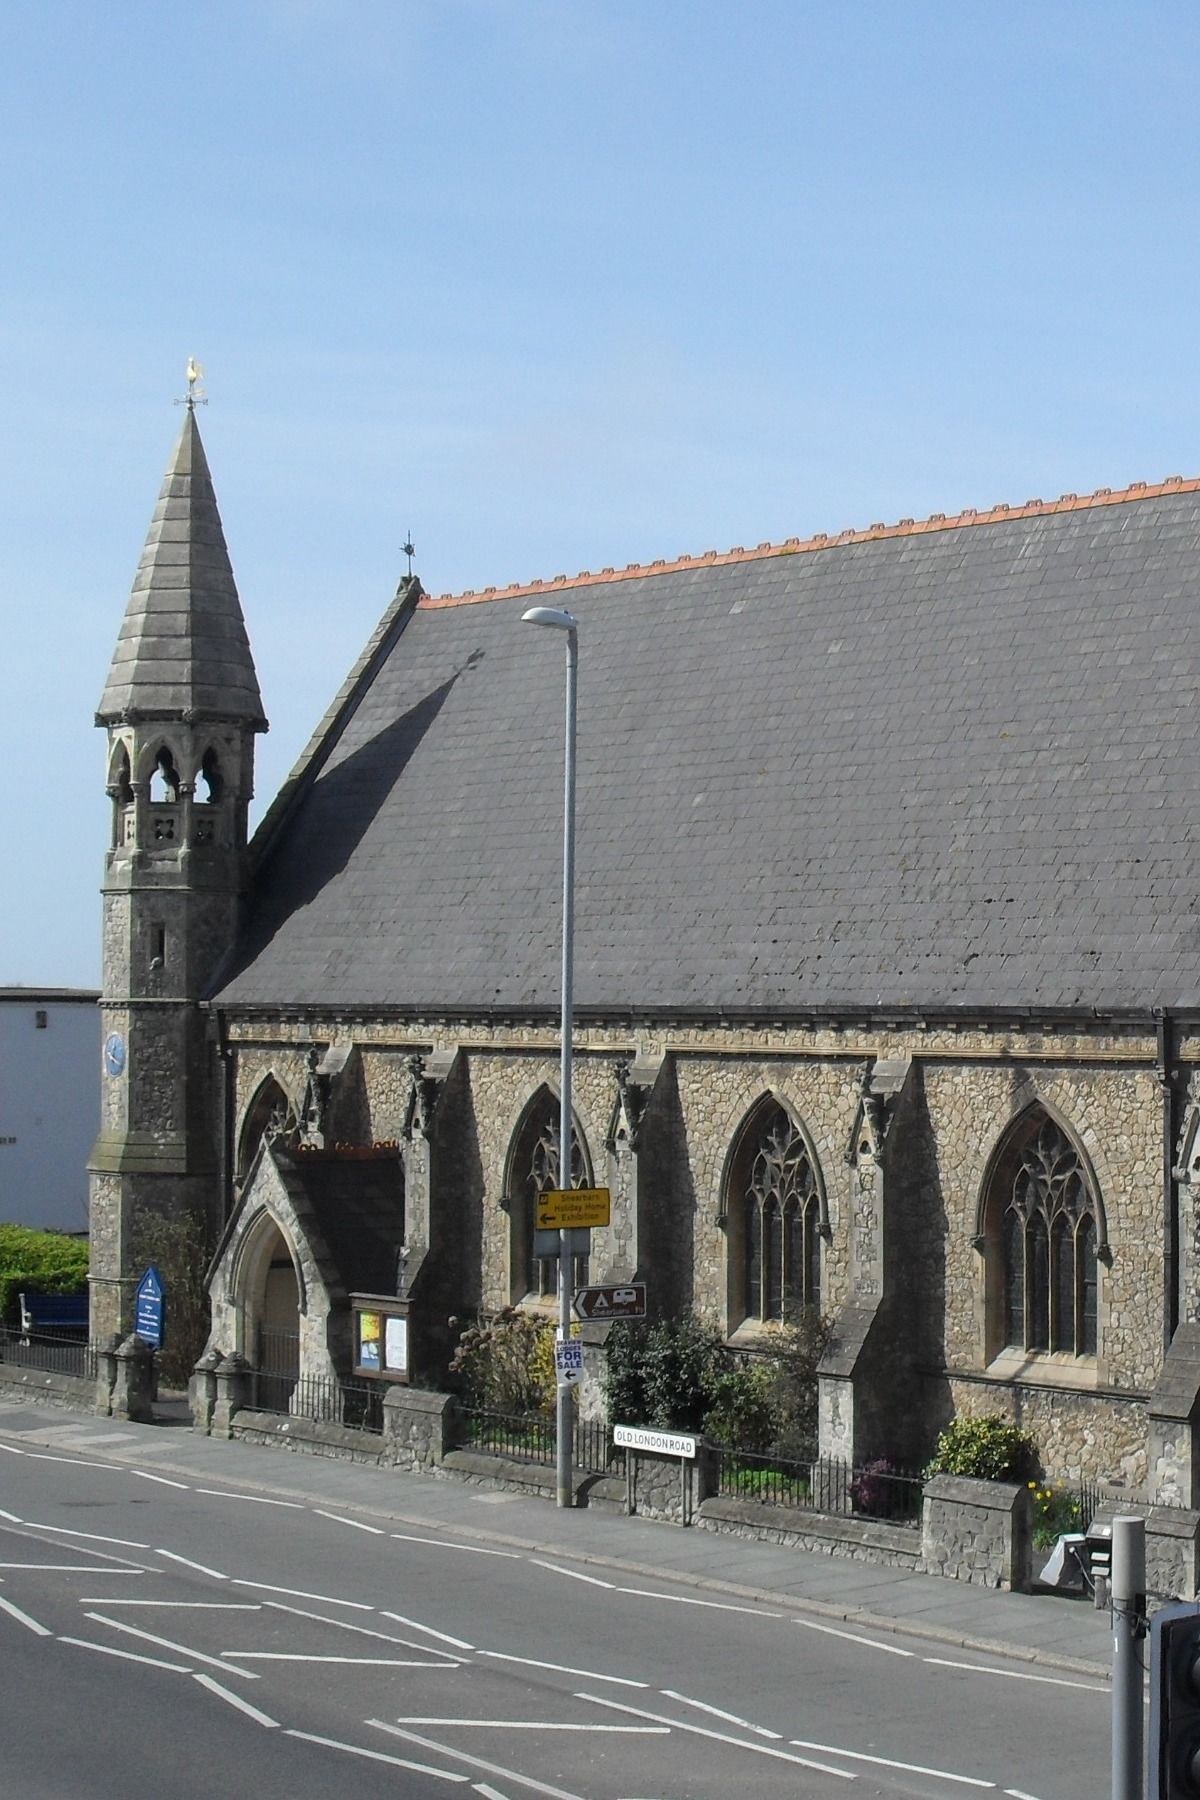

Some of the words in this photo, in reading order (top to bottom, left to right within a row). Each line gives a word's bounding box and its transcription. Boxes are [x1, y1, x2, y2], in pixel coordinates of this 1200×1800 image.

[557, 1352, 581, 1361] FOR
[557, 1361, 582, 1370] SALE
[616, 1431, 633, 1442] OLD
[634, 1434, 668, 1449] LONDON
[669, 1440, 692, 1453] ROAD
